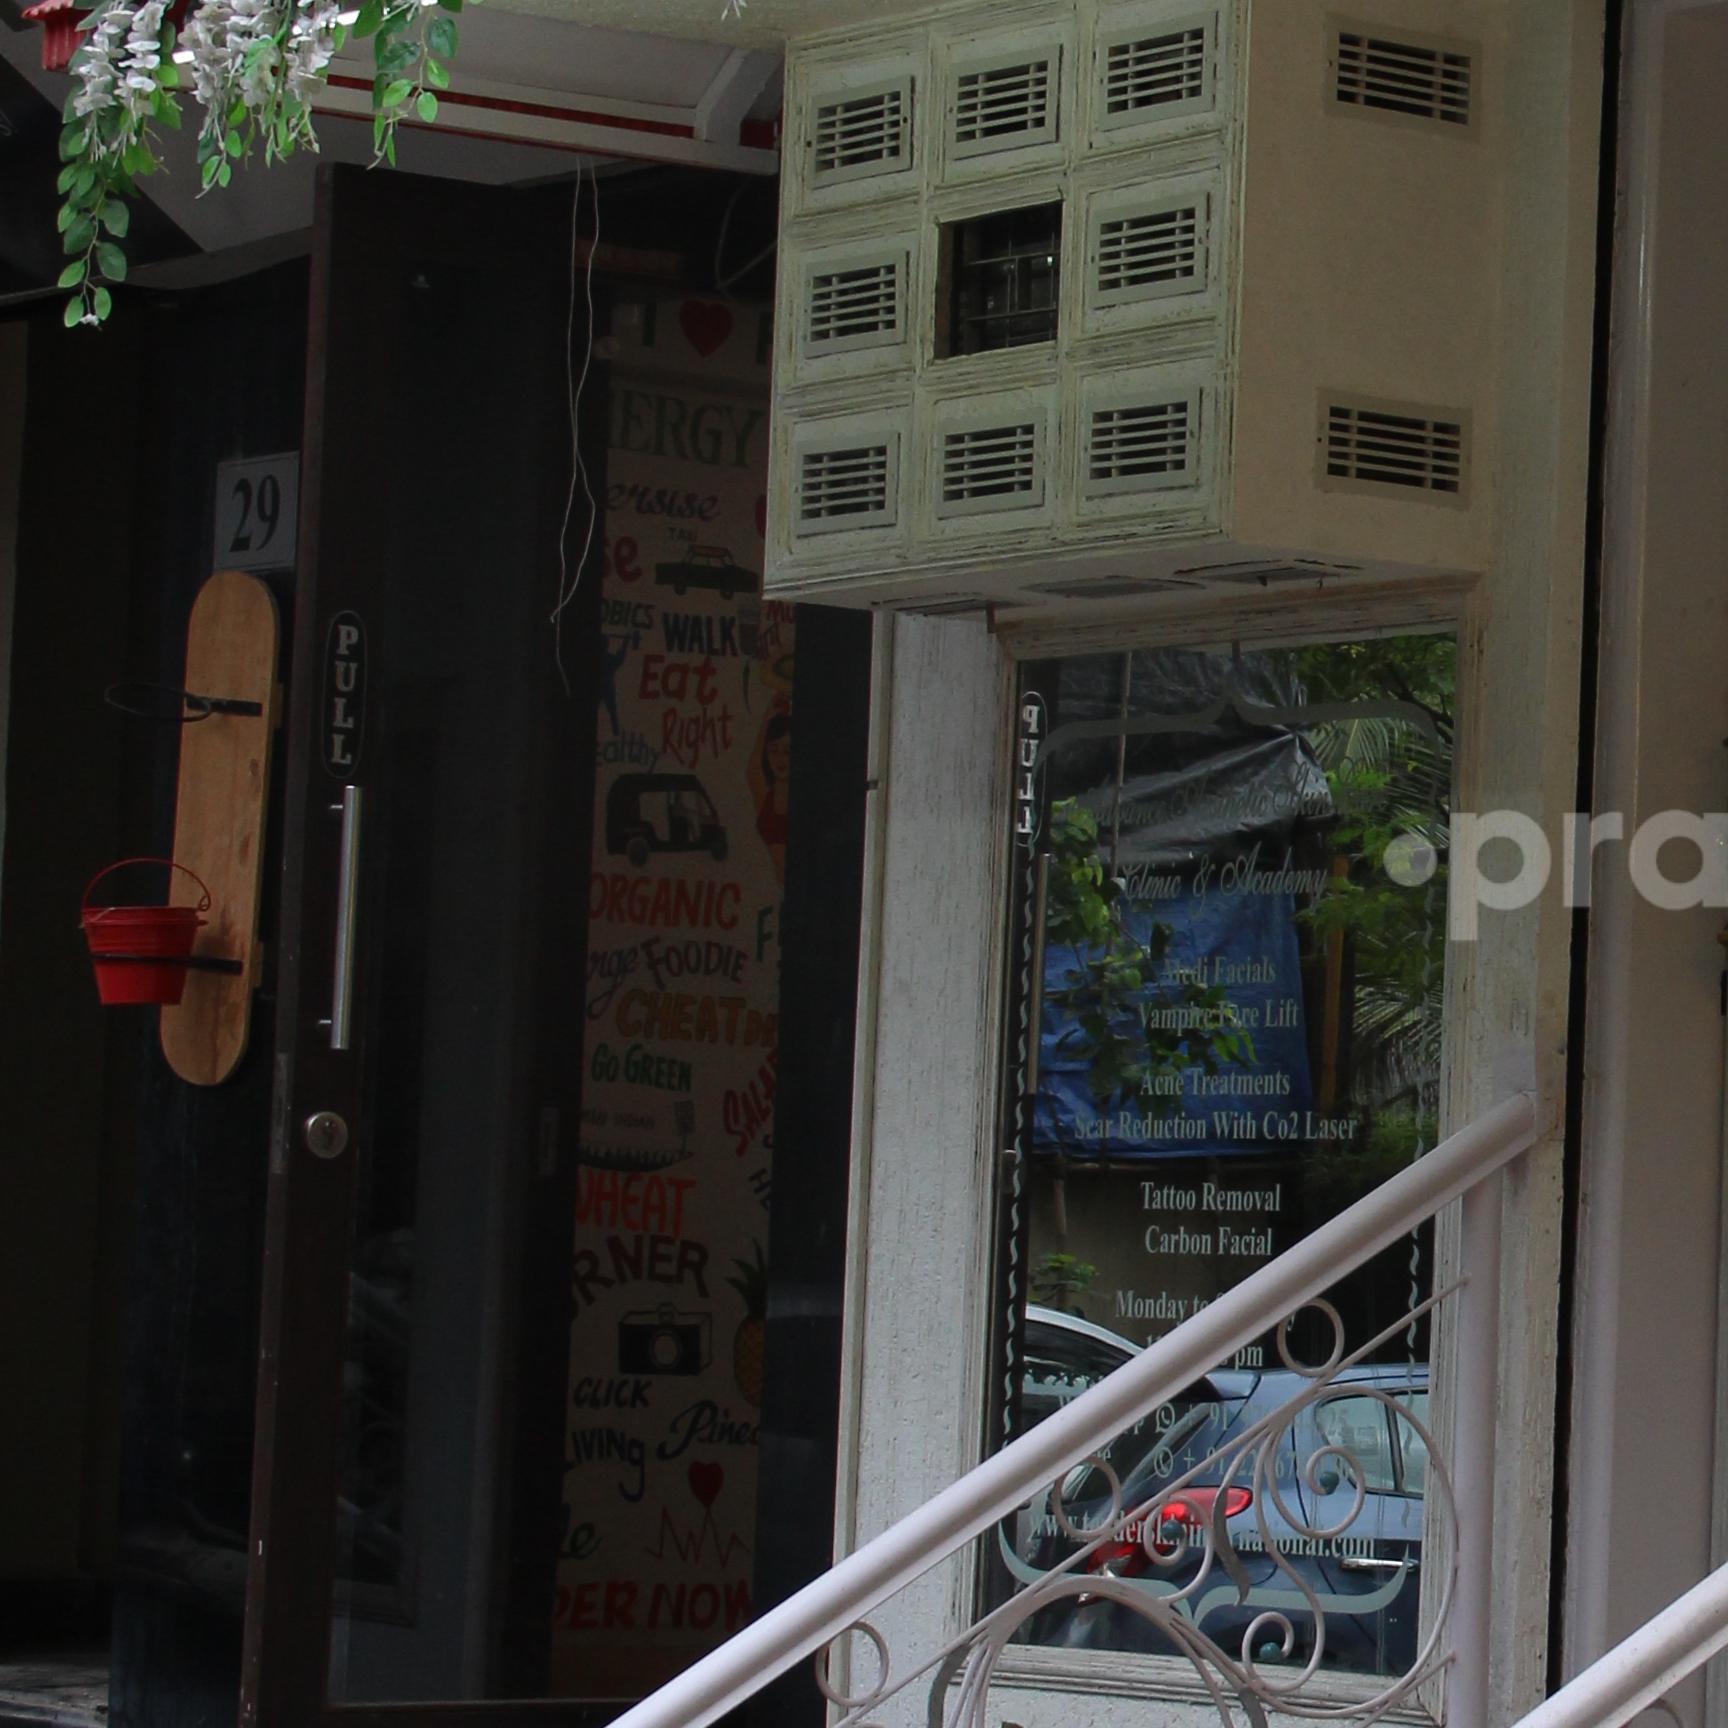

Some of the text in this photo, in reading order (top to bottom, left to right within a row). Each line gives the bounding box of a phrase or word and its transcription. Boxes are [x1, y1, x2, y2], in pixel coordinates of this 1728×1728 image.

[608, 387, 766, 470] ERGY
[229, 473, 281, 553] 29
[662, 612, 738, 658] WALK
[331, 623, 359, 766] PULL
[638, 654, 718, 706] Eat
[661, 706, 733, 769] Right
[1121, 860, 1183, 902] Clinic
[1220, 839, 1328, 910] Academy
[586, 872, 741, 930] ORGANIC
[1214, 954, 1277, 986] Facials
[1264, 997, 1299, 1028] Lift
[1139, 1069, 1291, 1098] Acne Treatments
[1074, 1110, 1360, 1141] Scar Reduction With Co2 Laser
[1139, 1181, 1281, 1213] Tattoo Removal
[1144, 1225, 1273, 1257] Carbon Facial
[1114, 1289, 1189, 1327] Monday
